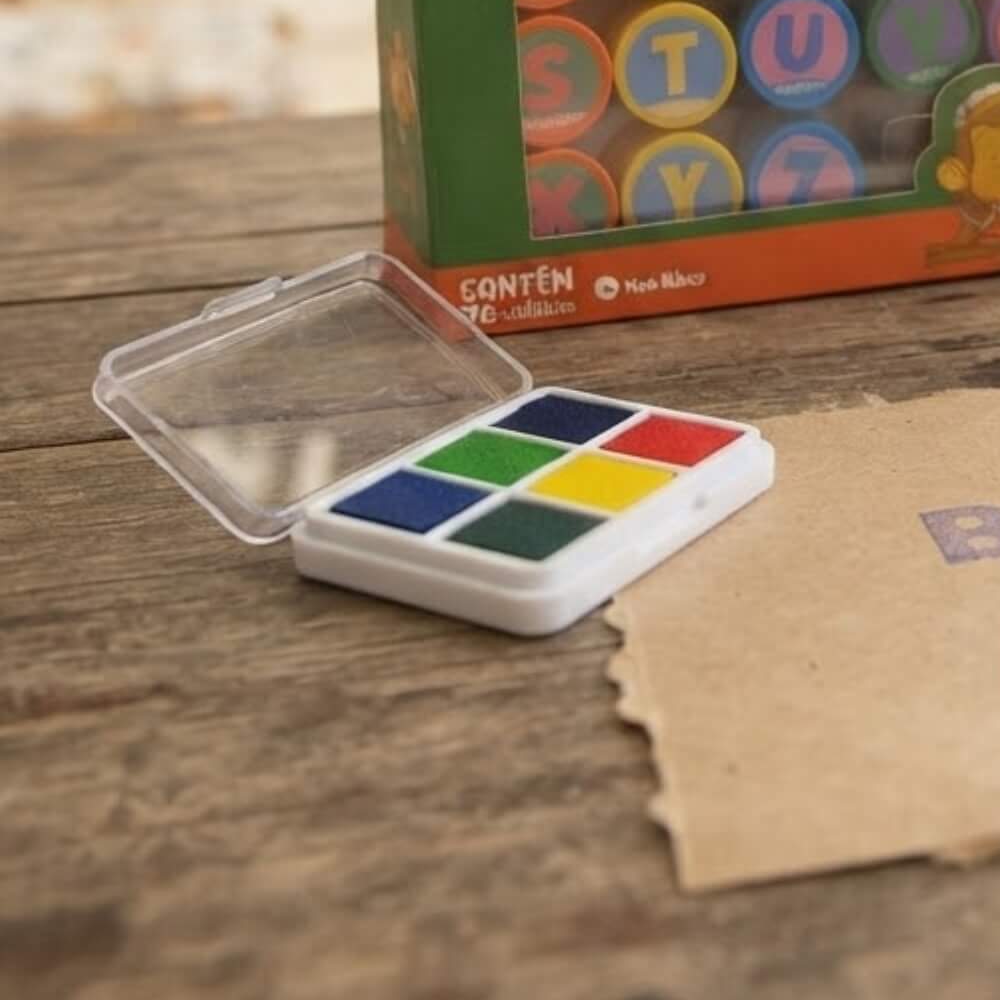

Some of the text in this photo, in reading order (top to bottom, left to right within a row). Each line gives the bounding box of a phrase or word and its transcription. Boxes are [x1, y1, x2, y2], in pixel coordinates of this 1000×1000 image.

[651, 31, 699, 97] T
[772, 13, 825, 74] U
[522, 42, 575, 111] S
[659, 161, 710, 224] Y
